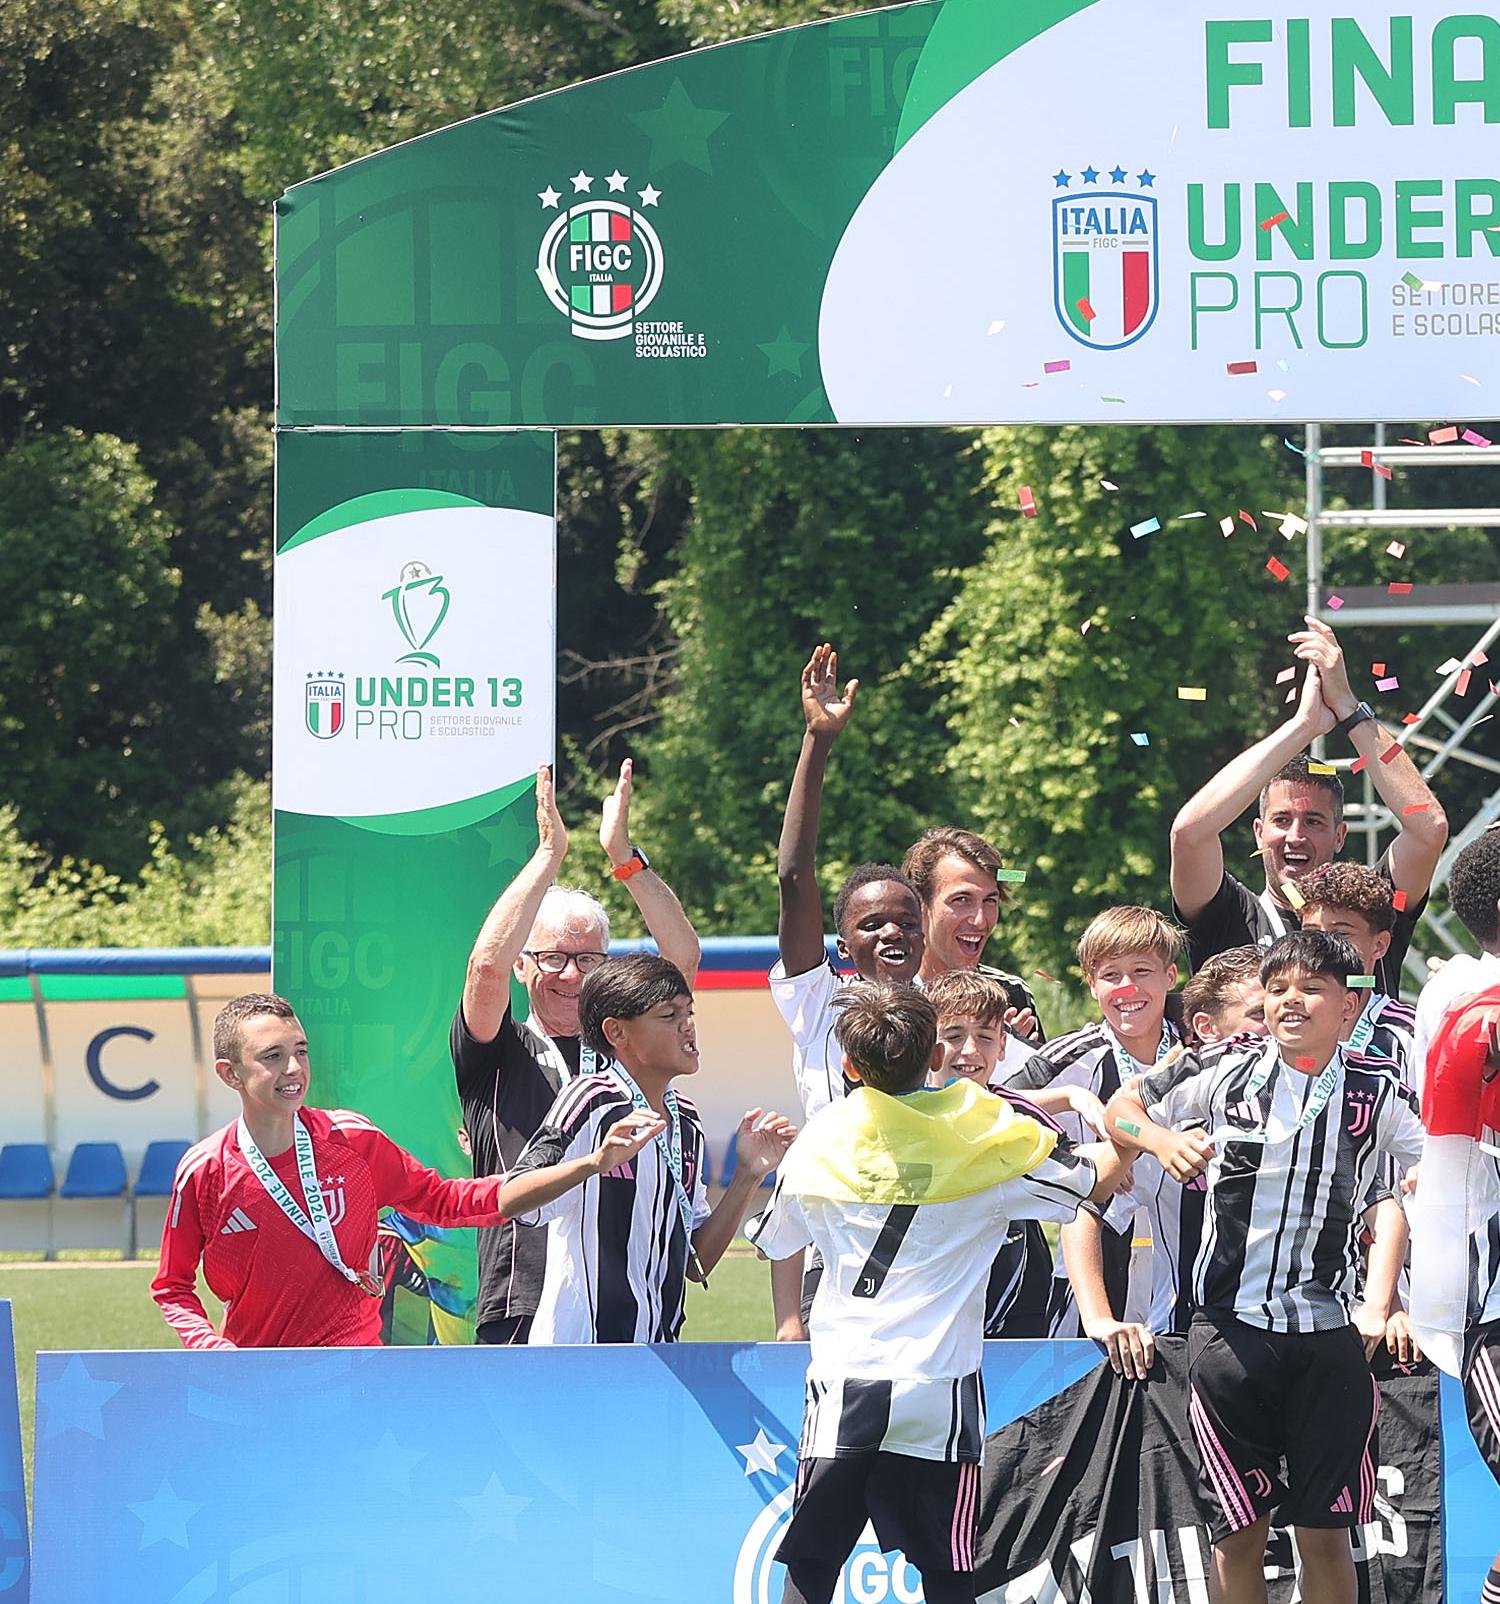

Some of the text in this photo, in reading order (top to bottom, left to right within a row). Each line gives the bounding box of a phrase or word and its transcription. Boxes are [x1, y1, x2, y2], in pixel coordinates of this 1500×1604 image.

[1062, 207, 1149, 235] ITALIA
[1093, 238, 1118, 248] FIGC
[570, 244, 632, 272] FIGC
[589, 273, 613, 282] ITALIA
[1392, 283, 1500, 306] SETTORE
[1190, 270, 1368, 350] PRO
[635, 321, 684, 334] SETTORE
[1392, 314, 1405, 336] E
[635, 333, 705, 346] GIOVANILE E
[635, 345, 707, 358] SCOLASTICO
[309, 685, 341, 697] ITALIA
[355, 677, 523, 708] UNDER 13
[355, 709, 422, 740] PRO
[430, 714, 523, 726] SETTORE GIOVANILE
[438, 726, 496, 737] SCOLASTICO
[1349, 1018, 1372, 1048] FINA
[86, 1025, 161, 1100] C
[1303, 1091, 1327, 1125] NALE
[247, 1145, 308, 1227] FINALE 2026
[296, 1130, 327, 1223] FINALE 2026
[855, 1162, 933, 1298] 7
[832, 1551, 925, 1604] GC
